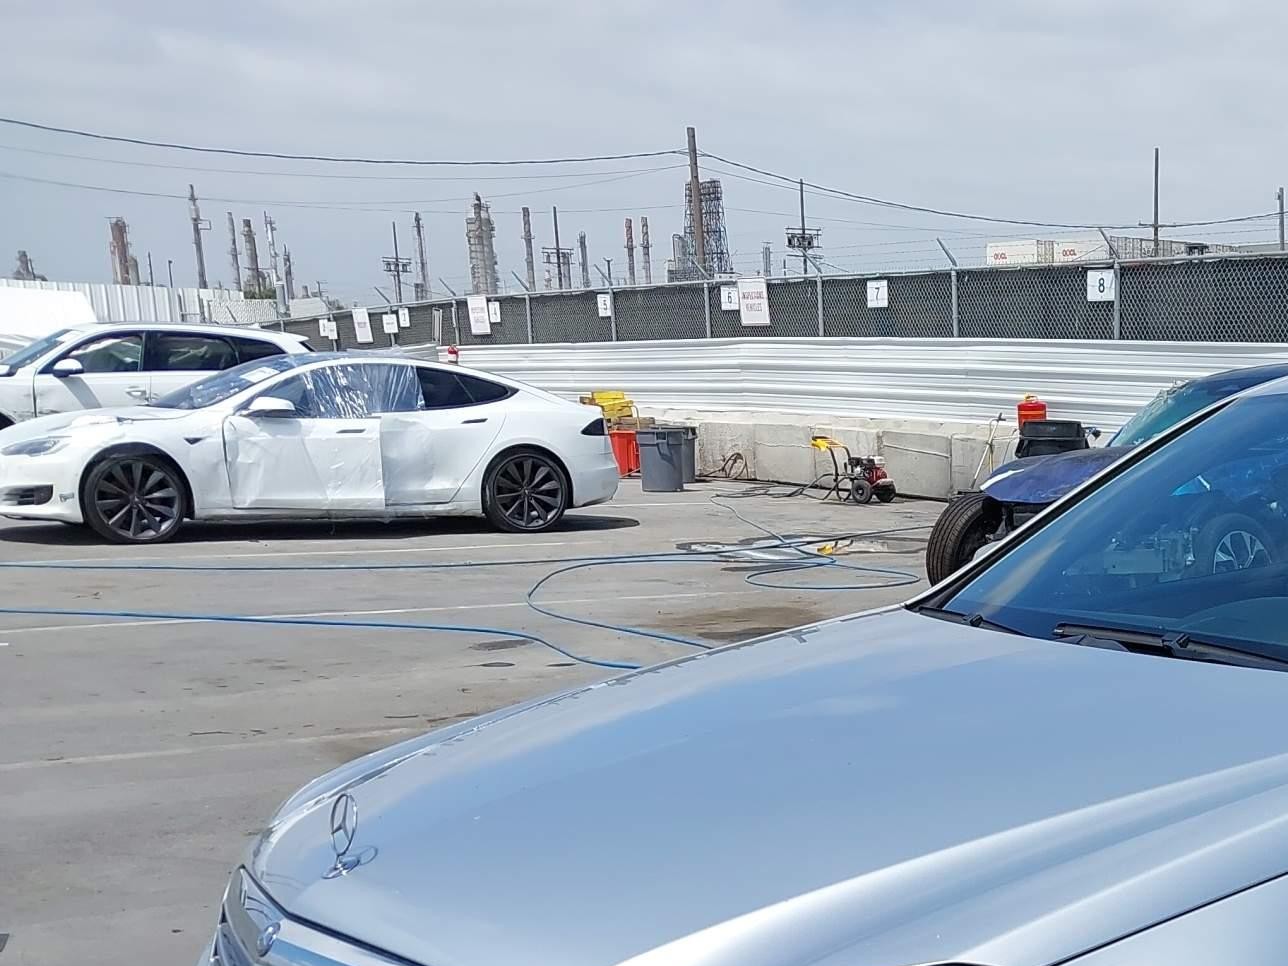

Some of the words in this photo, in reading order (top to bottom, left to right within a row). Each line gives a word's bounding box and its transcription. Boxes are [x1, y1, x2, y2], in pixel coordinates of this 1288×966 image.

[1098, 277, 1105, 294] 8
[727, 292, 733, 304] 6
[874, 287, 880, 300] 7
